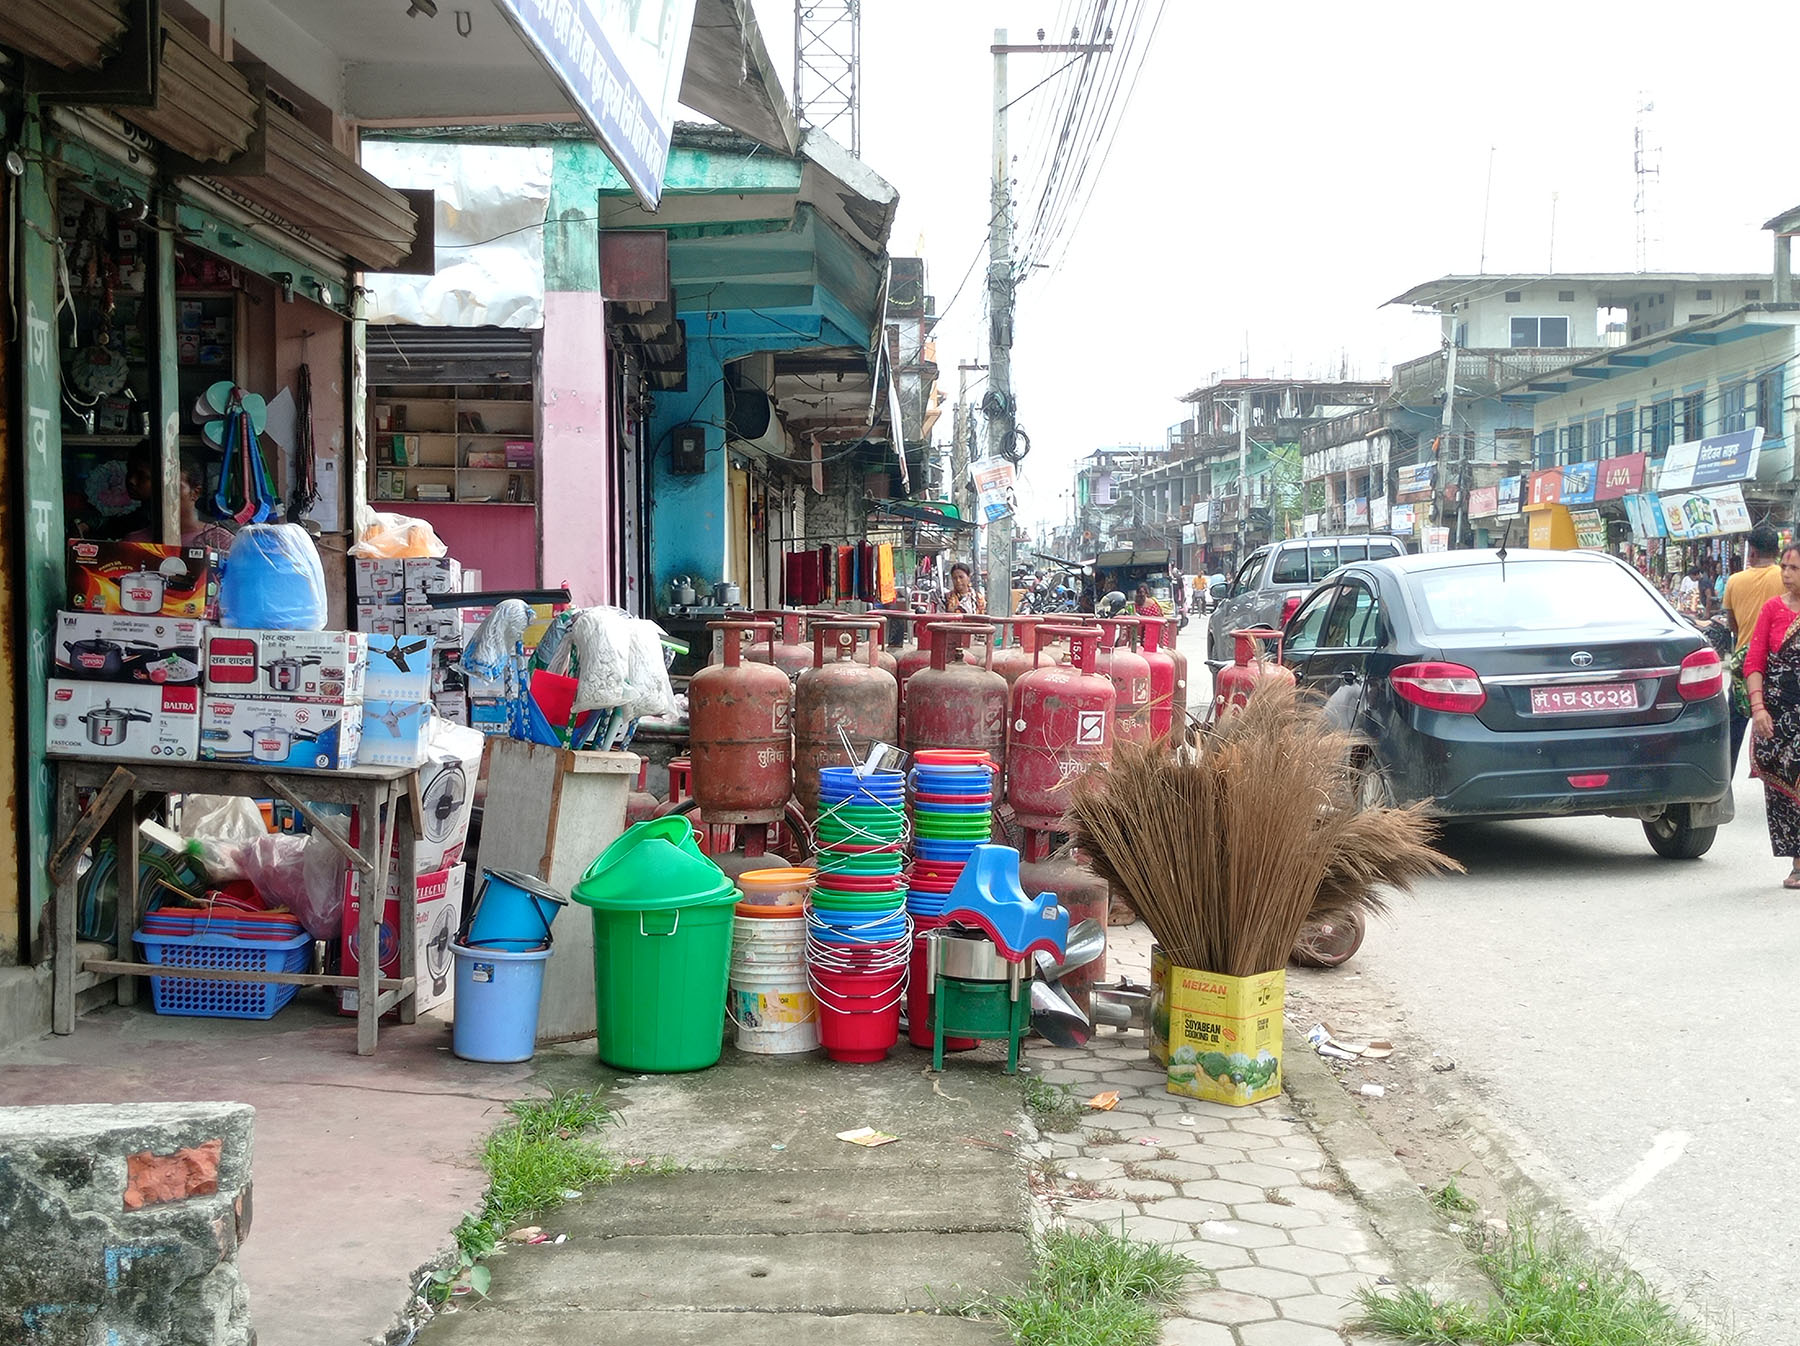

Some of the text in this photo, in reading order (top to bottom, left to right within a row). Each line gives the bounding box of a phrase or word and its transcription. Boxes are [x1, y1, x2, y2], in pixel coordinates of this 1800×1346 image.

[1606, 467, 1631, 488] LAVA
[163, 701, 194, 711] BALTRA
[1182, 979, 1227, 996] MEIZAN
[1184, 1019, 1221, 1035] SOYABEAN
[1184, 1029, 1220, 1044] COOKING OIL
